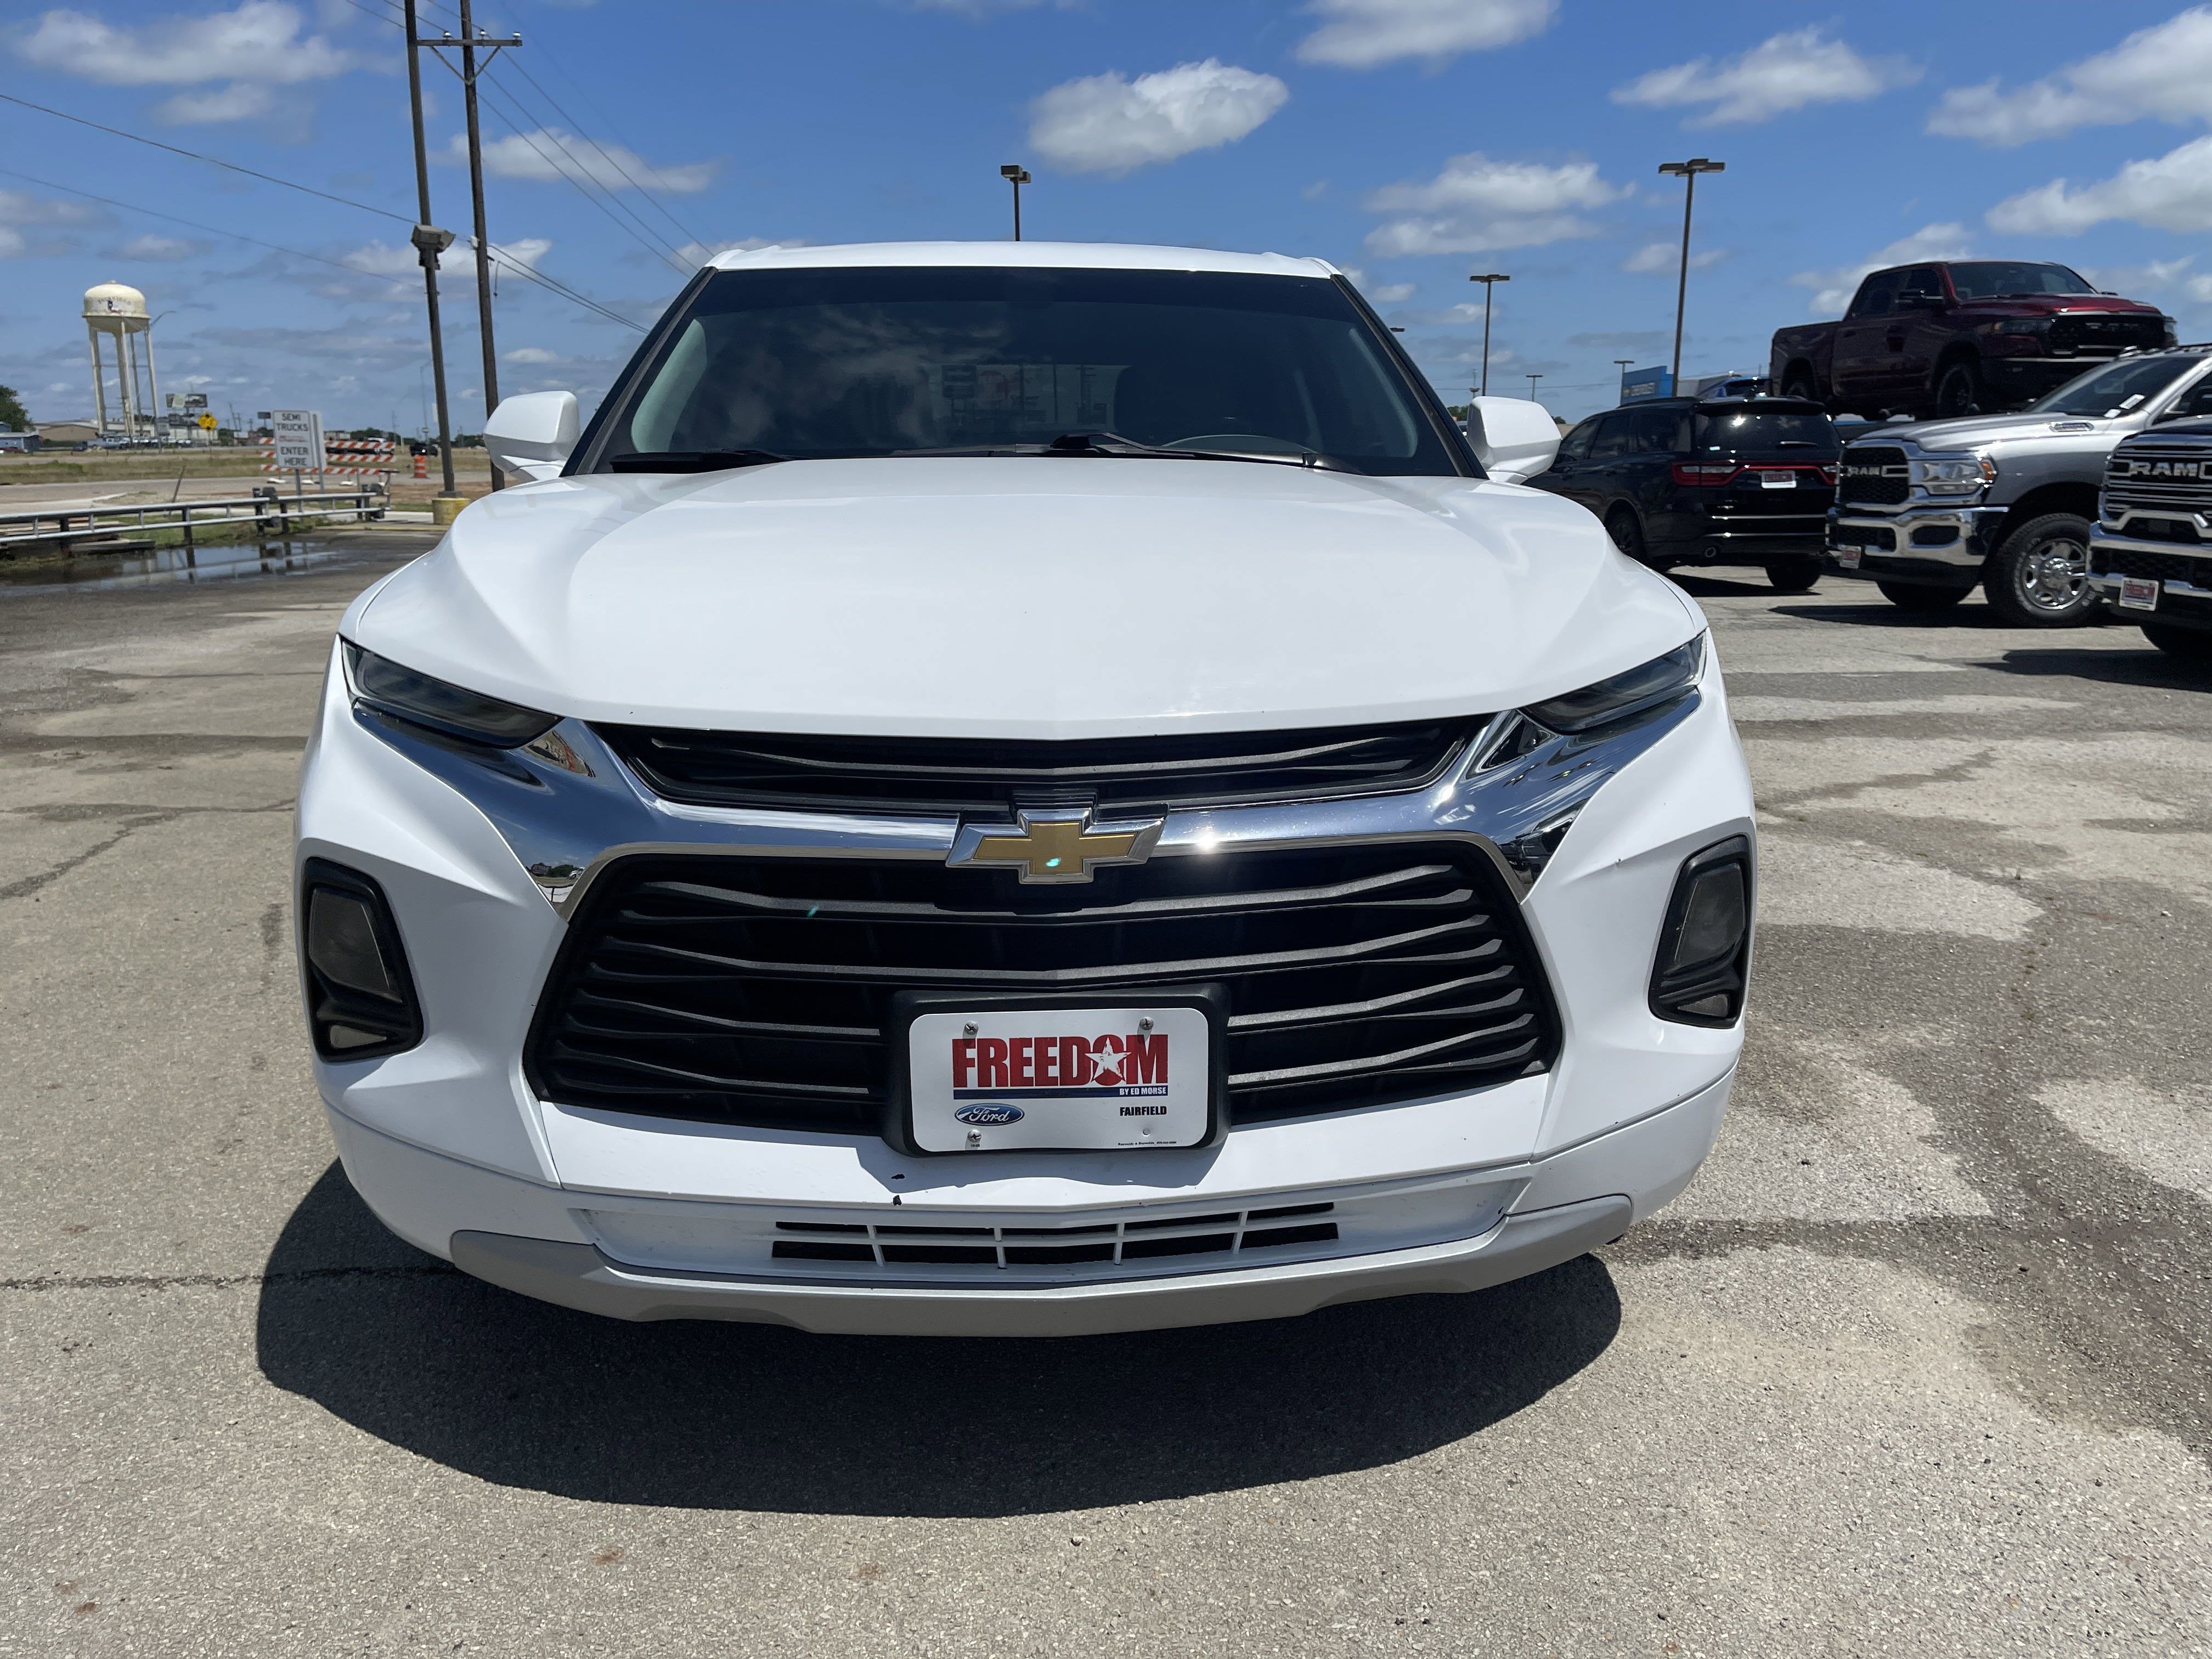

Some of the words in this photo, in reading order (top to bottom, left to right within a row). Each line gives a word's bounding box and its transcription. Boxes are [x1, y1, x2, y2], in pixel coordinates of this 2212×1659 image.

[281, 413, 301, 421] SEMI
[276, 422, 308, 431] TRUCKS
[280, 446, 309, 455] ENTER
[284, 457, 307, 466] HERE
[1847, 466, 1880, 476] RAM
[2130, 462, 2198, 477] RAM
[952, 1034, 1168, 1087] FREEDOM
[969, 1107, 1010, 1121] Ford
[1120, 1106, 1167, 1116] FAIRFIELD
